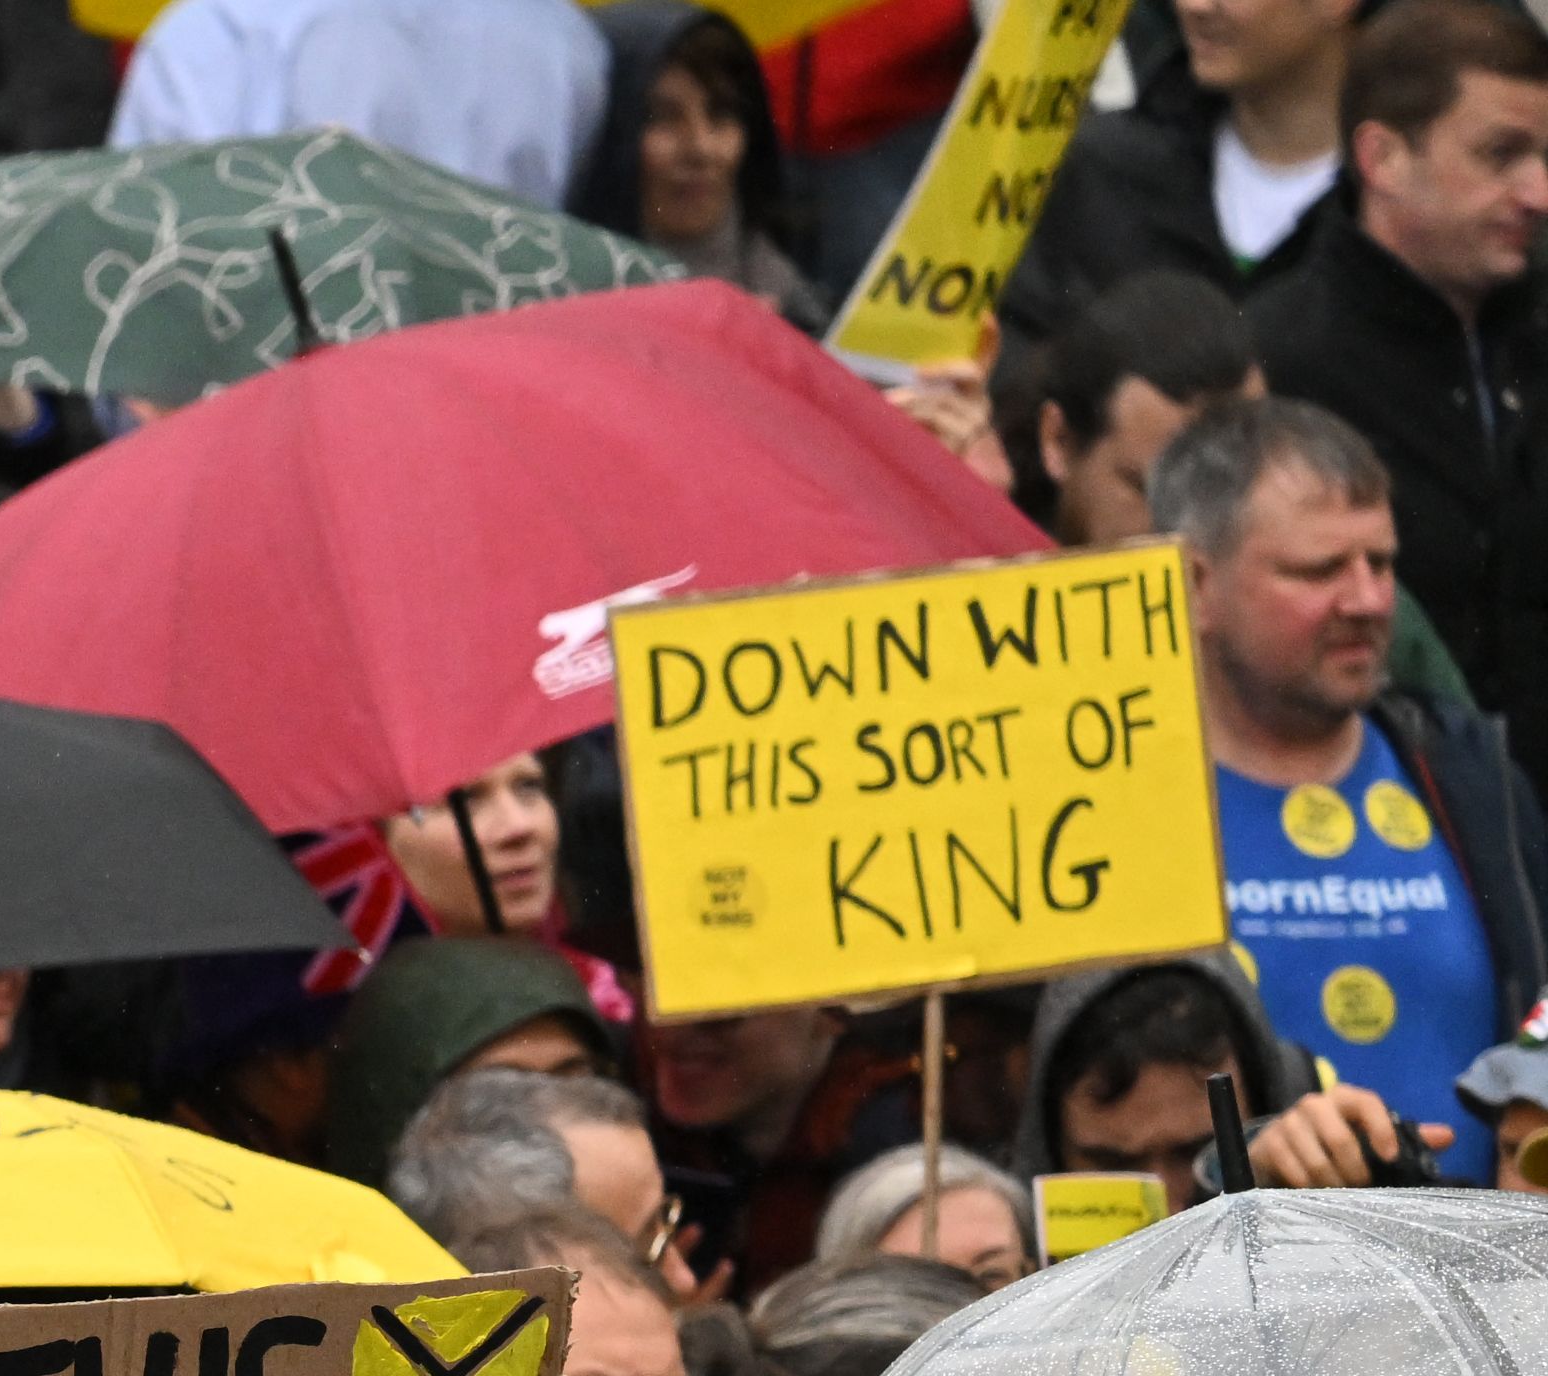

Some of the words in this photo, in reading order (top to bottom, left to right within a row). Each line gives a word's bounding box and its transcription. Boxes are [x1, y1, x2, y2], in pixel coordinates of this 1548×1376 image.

[648, 601, 931, 730] DOWN
[967, 567, 1179, 668] WITH
[662, 737, 823, 819] THIS
[856, 707, 1022, 794] SORT
[1065, 686, 1155, 770] OF
[829, 797, 1111, 948] KING
